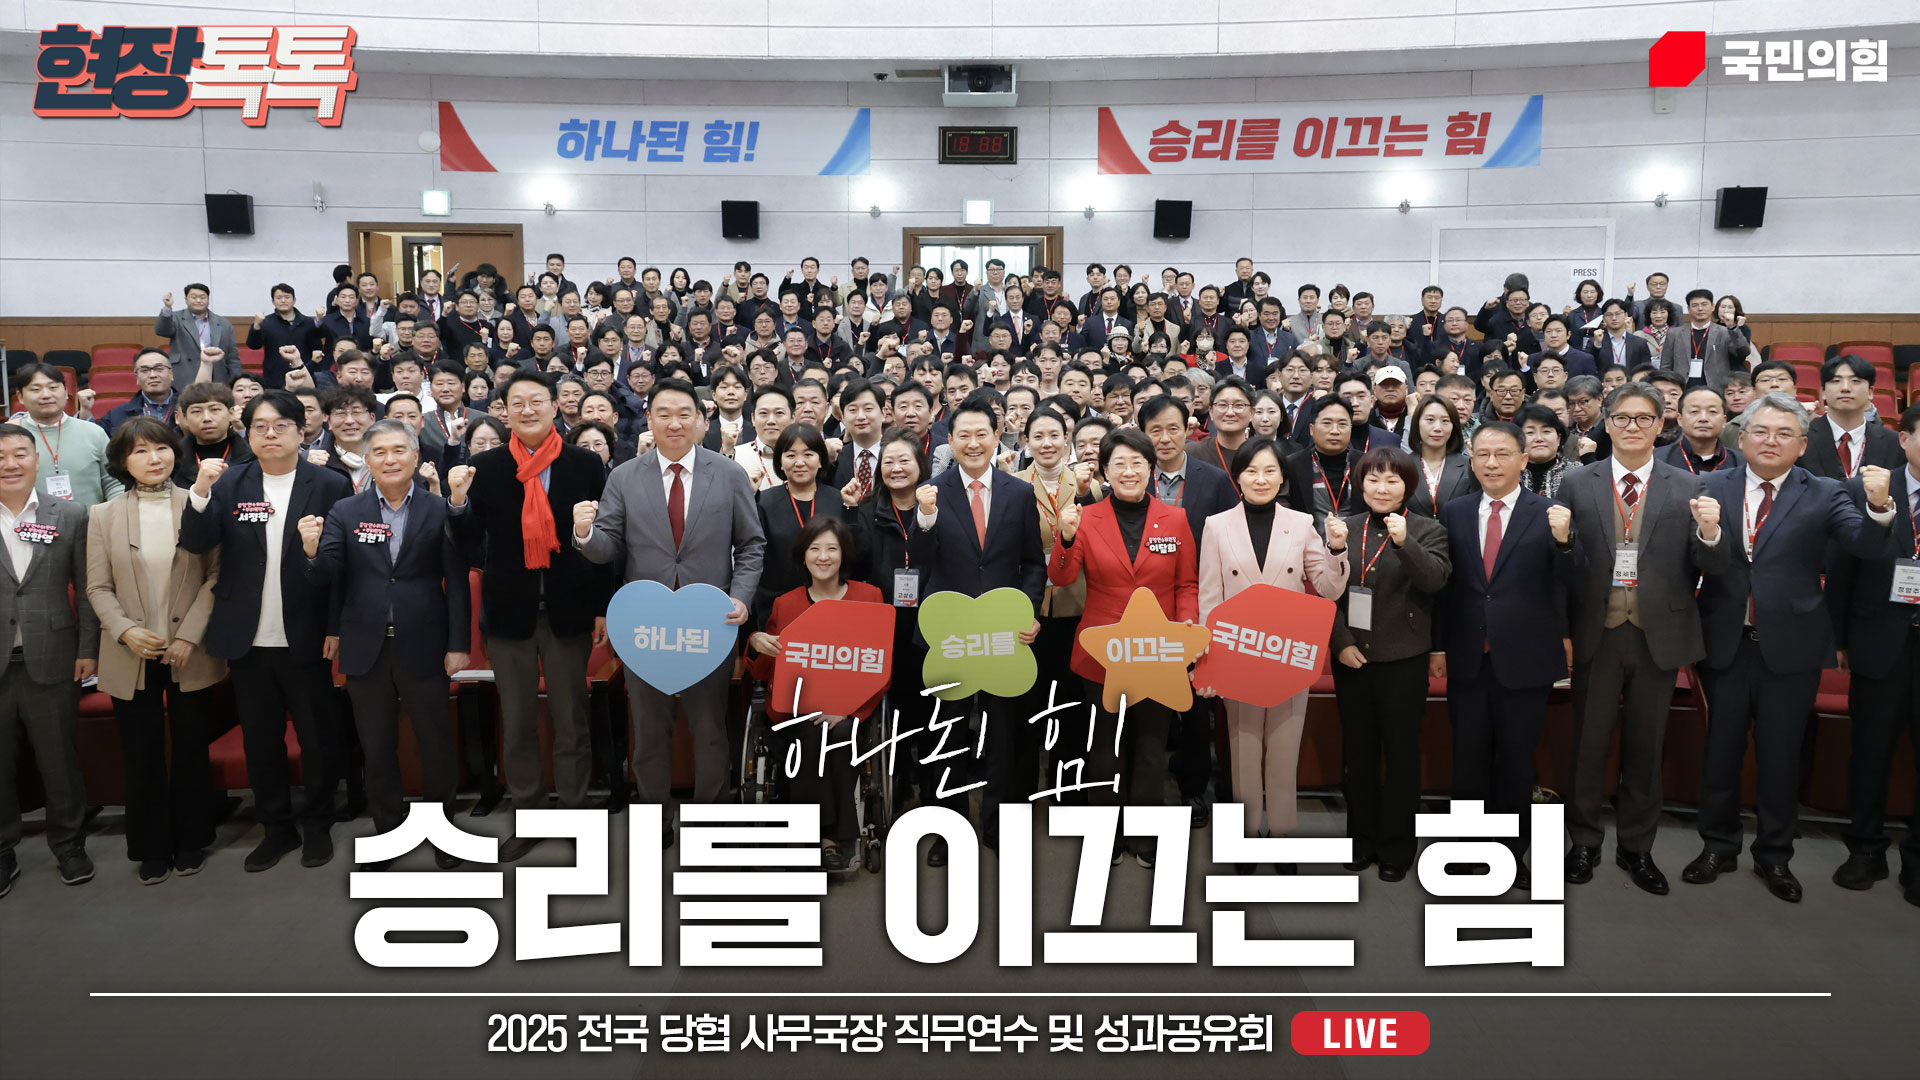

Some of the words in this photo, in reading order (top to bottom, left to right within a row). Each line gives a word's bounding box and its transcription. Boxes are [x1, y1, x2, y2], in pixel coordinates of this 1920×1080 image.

[557, 118, 689, 163] 하나된
[703, 119, 761, 163] 힘!
[1148, 118, 1281, 163] 승리를
[1292, 115, 1429, 158] 이끄는
[1445, 111, 1491, 155] 힘
[1573, 268, 1598, 277] PRESS
[238, 512, 268, 522] 서정현
[357, 532, 386, 544] 김현기
[1149, 543, 1177, 554] 이달희
[634, 625, 709, 653] 하나된
[940, 631, 1016, 659] 승리를
[1106, 634, 1185, 663] 이끄는
[1211, 619, 1319, 671] 국민의힘
[785, 641, 885, 675] 국민의힘
